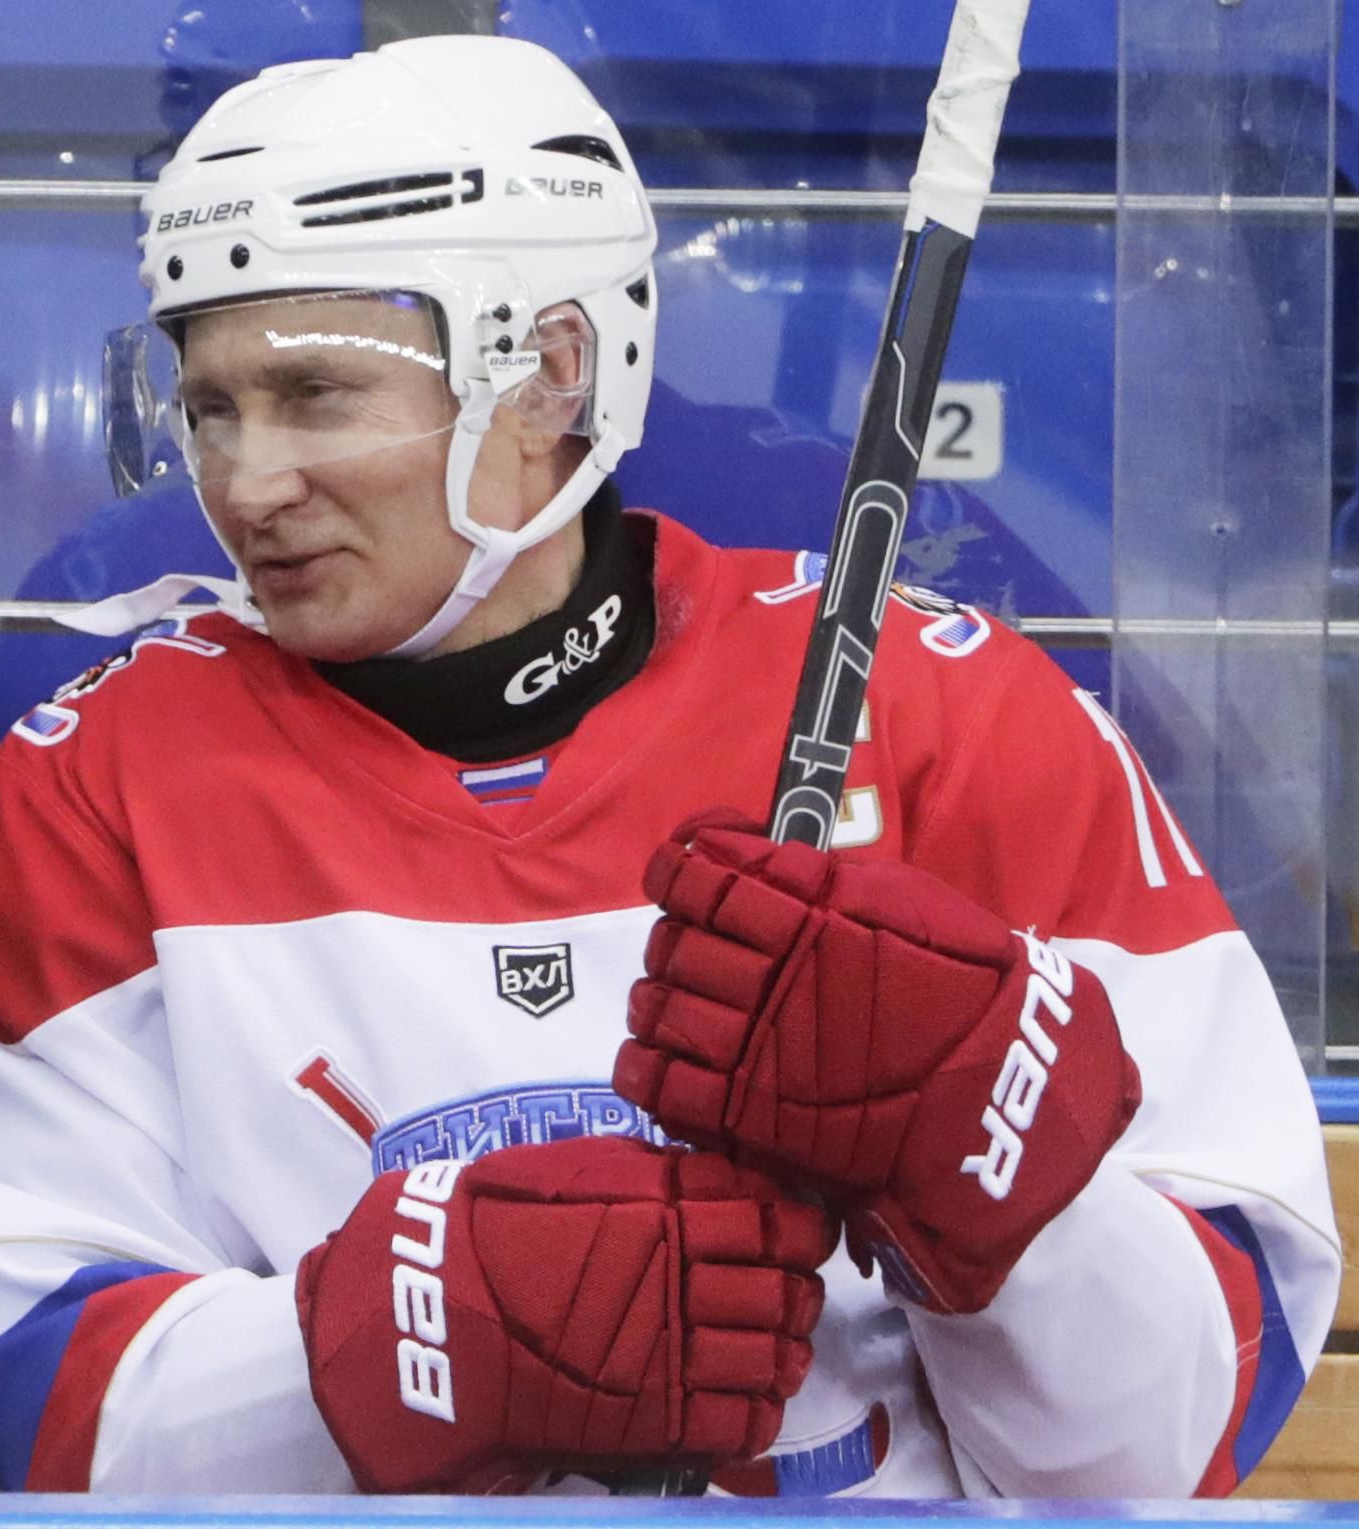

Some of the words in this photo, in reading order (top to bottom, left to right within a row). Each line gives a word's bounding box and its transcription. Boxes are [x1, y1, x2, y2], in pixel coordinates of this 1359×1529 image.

[157, 200, 254, 232] BAUER
[935, 402, 974, 460] 2
[504, 594, 623, 706] G&P
[500, 958, 569, 995] ВХЛ
[959, 923, 1074, 1201] AUER
[377, 1086, 695, 1173] ТИГР
[391, 1158, 474, 1425] BAUE
